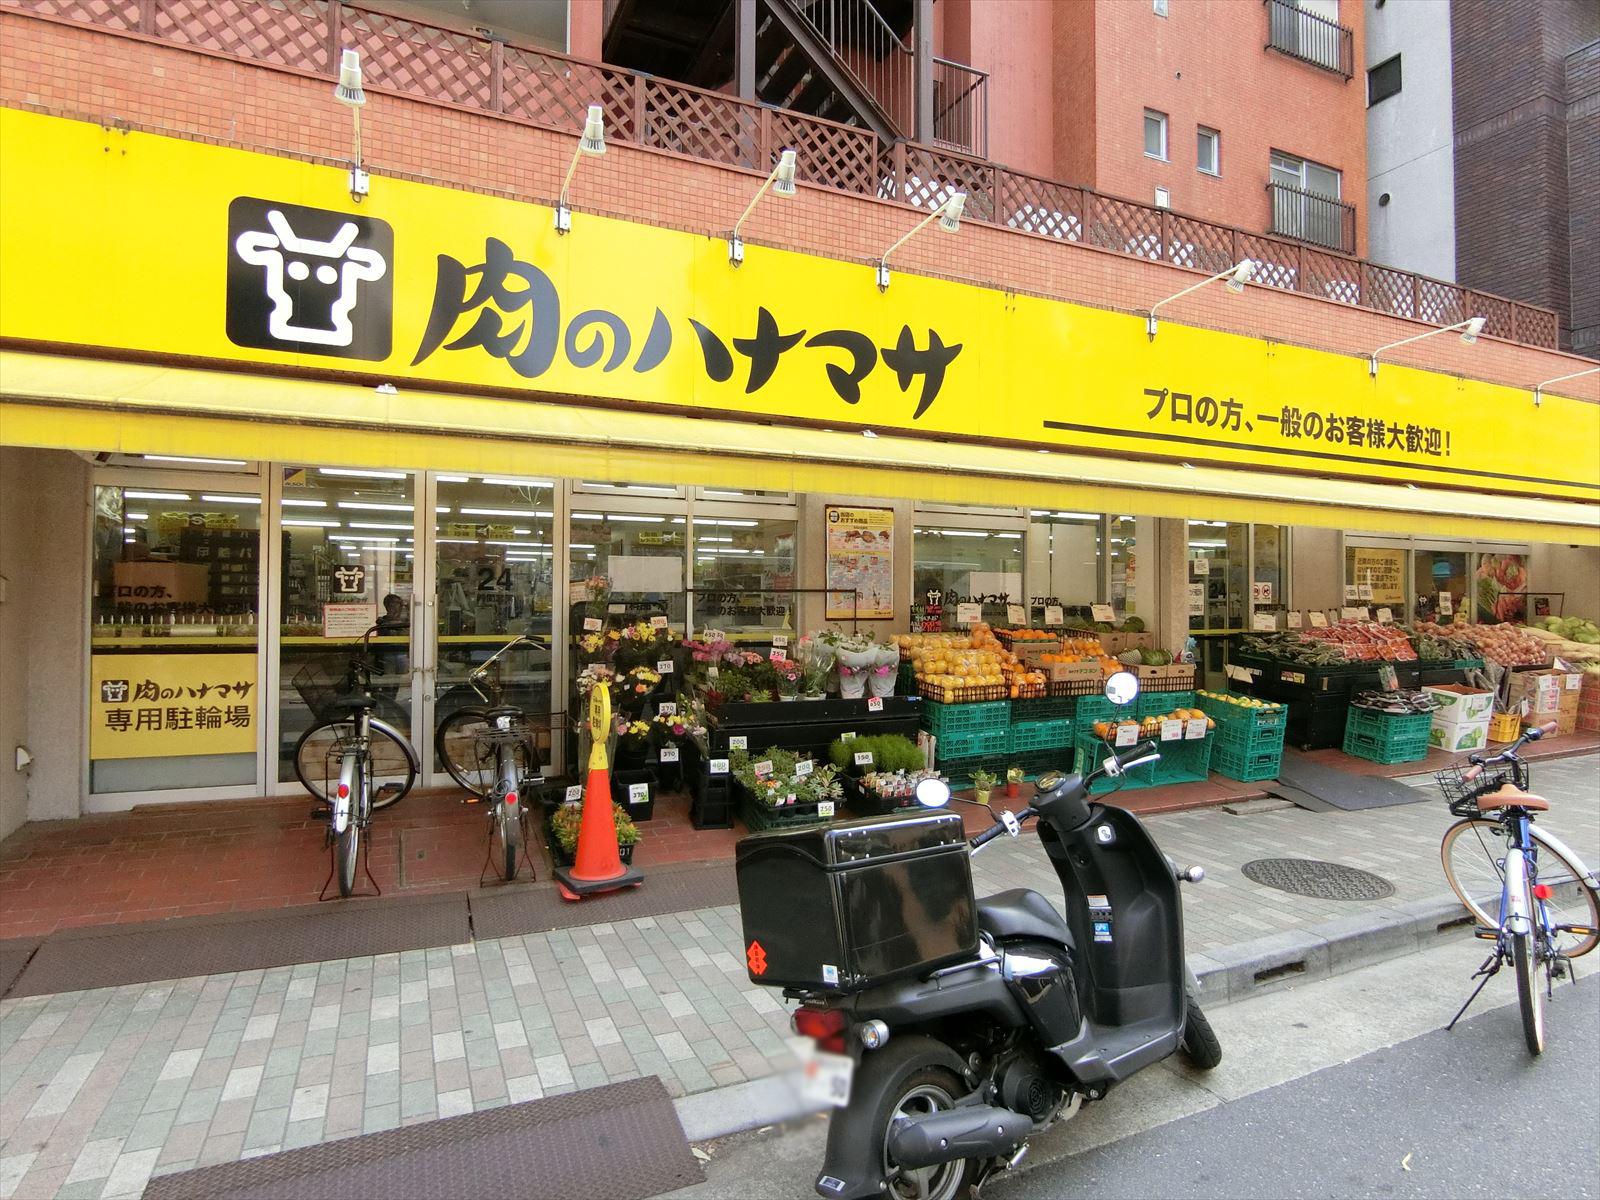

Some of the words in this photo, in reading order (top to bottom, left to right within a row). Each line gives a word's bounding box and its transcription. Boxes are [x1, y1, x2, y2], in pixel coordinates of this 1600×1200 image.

[410, 237, 962, 419] 肉のハナマサ
[478, 568, 513, 591] 24
[133, 680, 254, 701] 肉のハナマサ
[105, 705, 251, 731] 専用駐輪場
